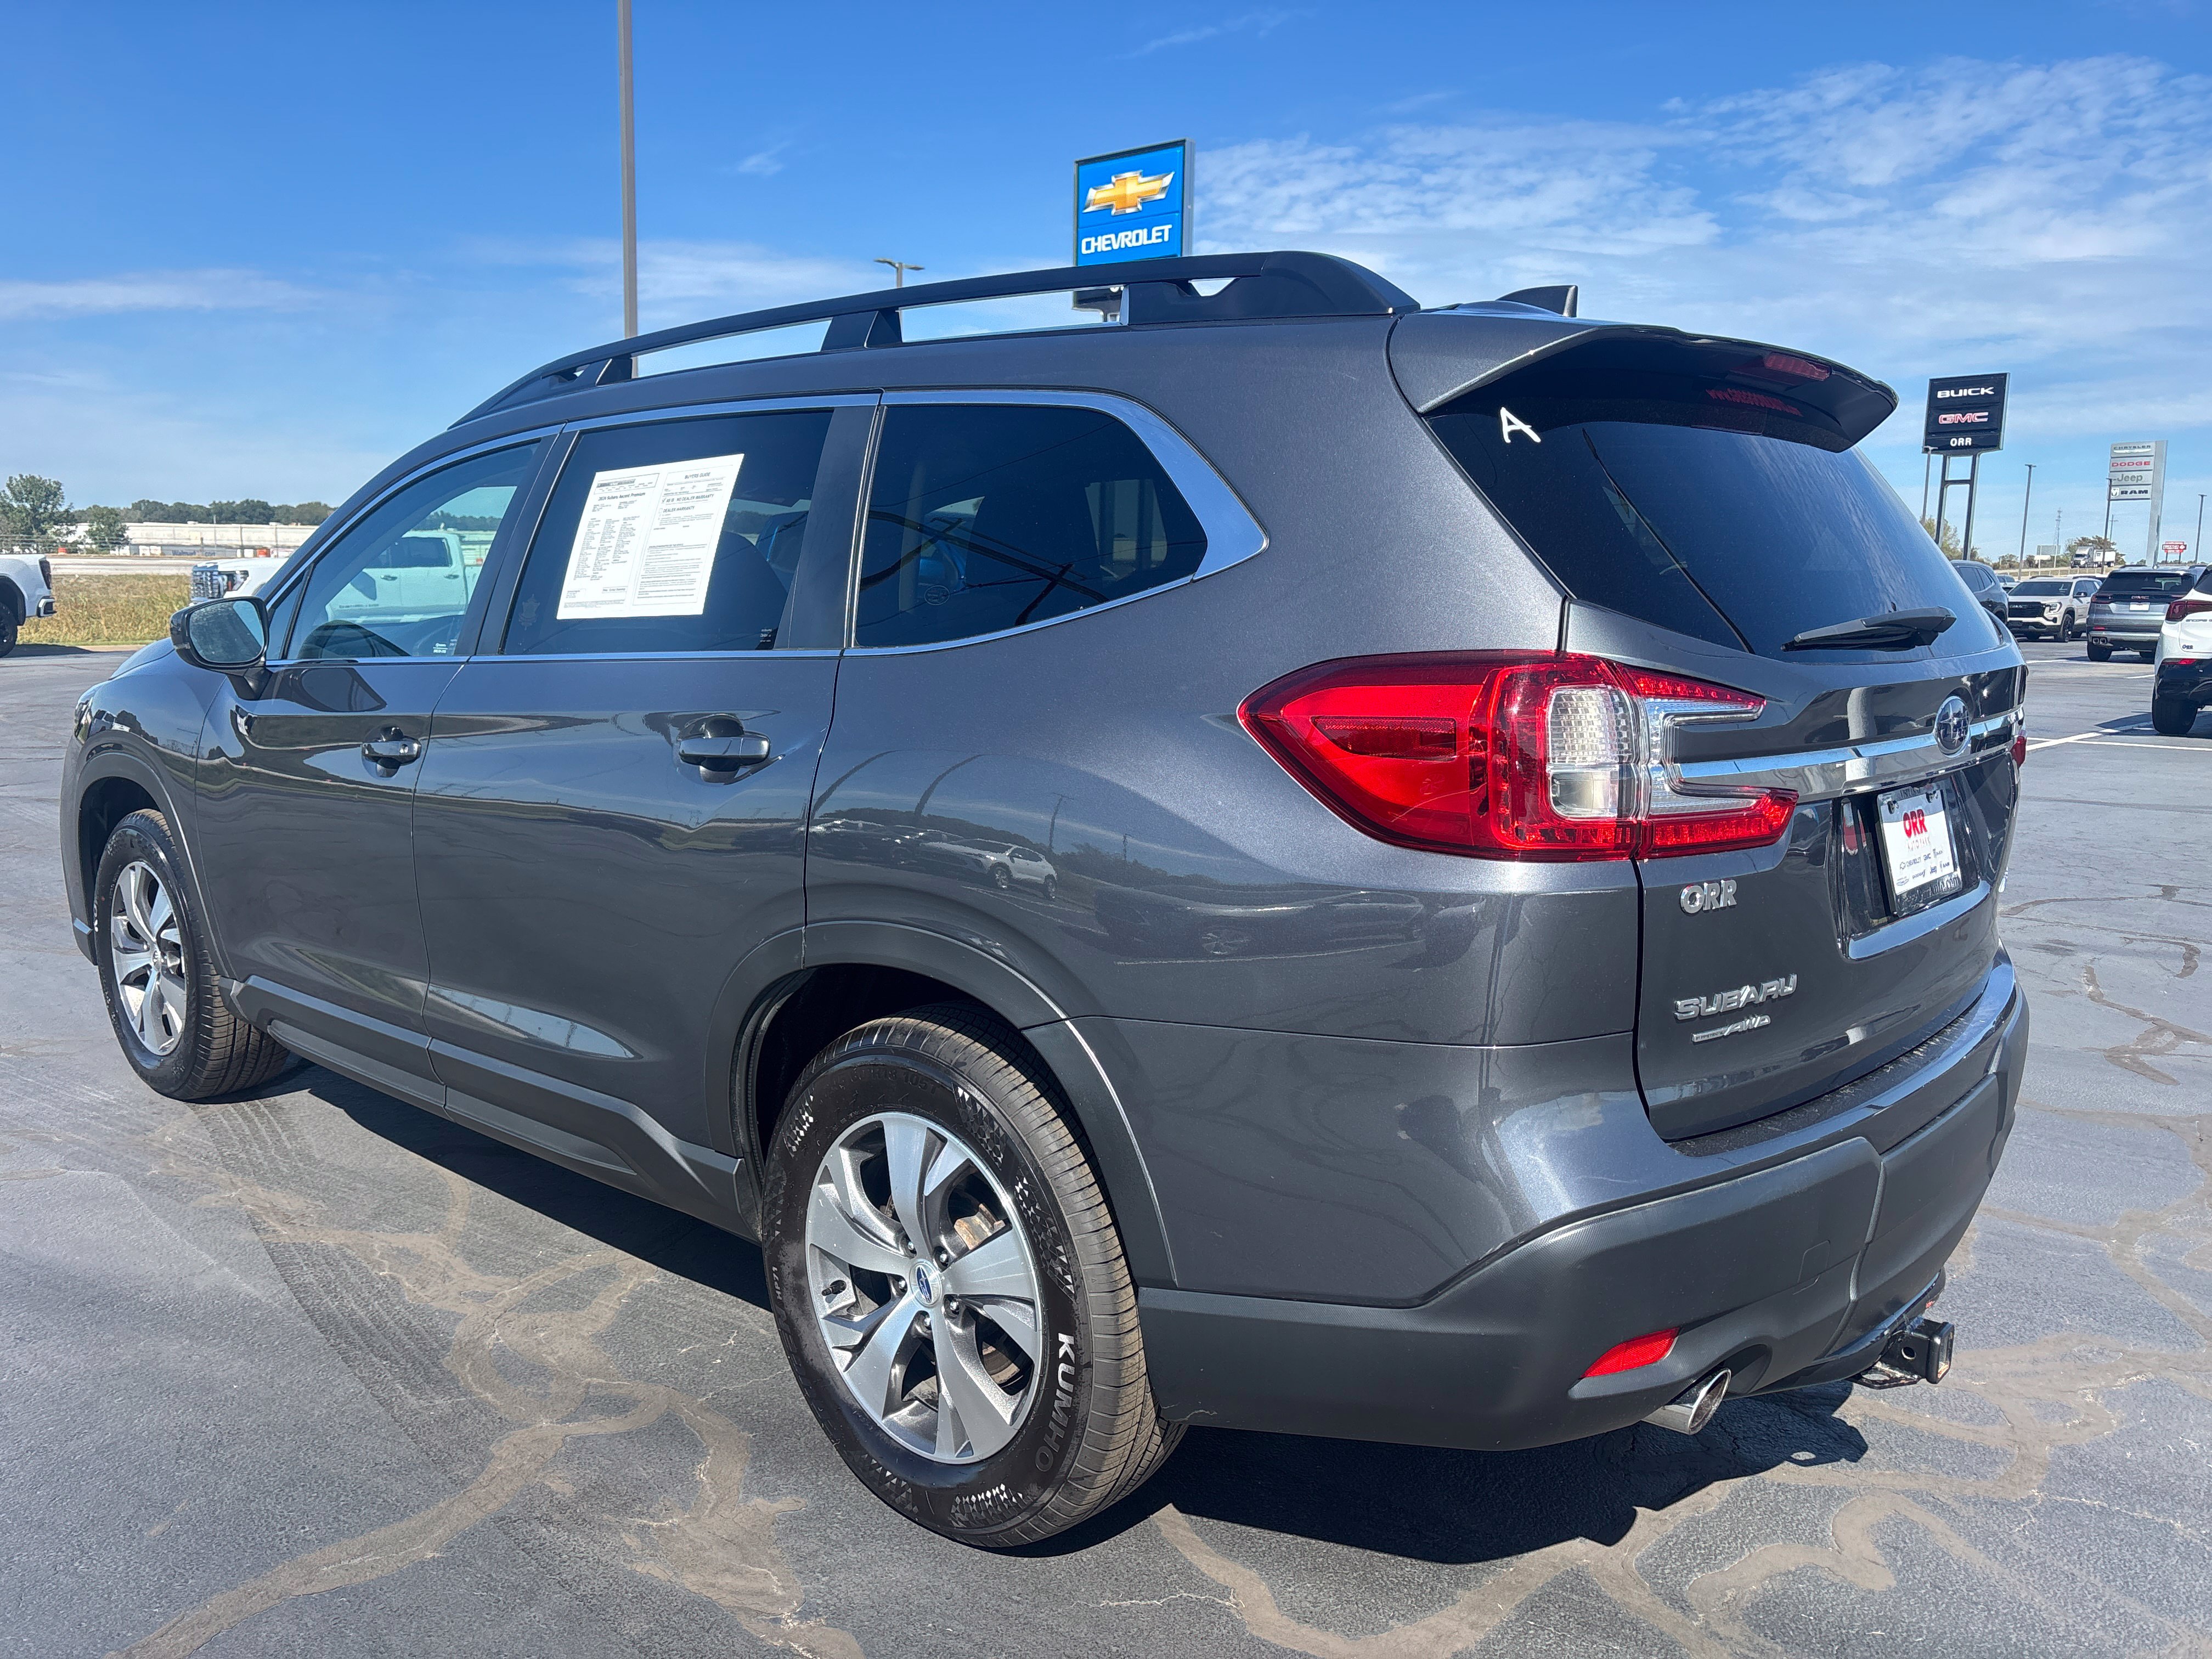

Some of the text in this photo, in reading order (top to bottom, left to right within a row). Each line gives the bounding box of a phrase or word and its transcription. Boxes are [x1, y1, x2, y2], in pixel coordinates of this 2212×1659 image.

[1081, 224, 1172, 254] CHEVROLET
[1937, 387, 1994, 398] BUICK
[1500, 407, 1541, 443] A
[1938, 412, 1989, 424] GMC
[1950, 437, 1972, 447] ORR
[2117, 473, 2143, 483] Jeep
[1902, 809, 1928, 838] ORR
[1680, 879, 1737, 914] ORR
[1674, 973, 1798, 1020] SUBARU
[772, 1266, 782, 1301] HP71
[1035, 1333, 1075, 1472] KUMHO
